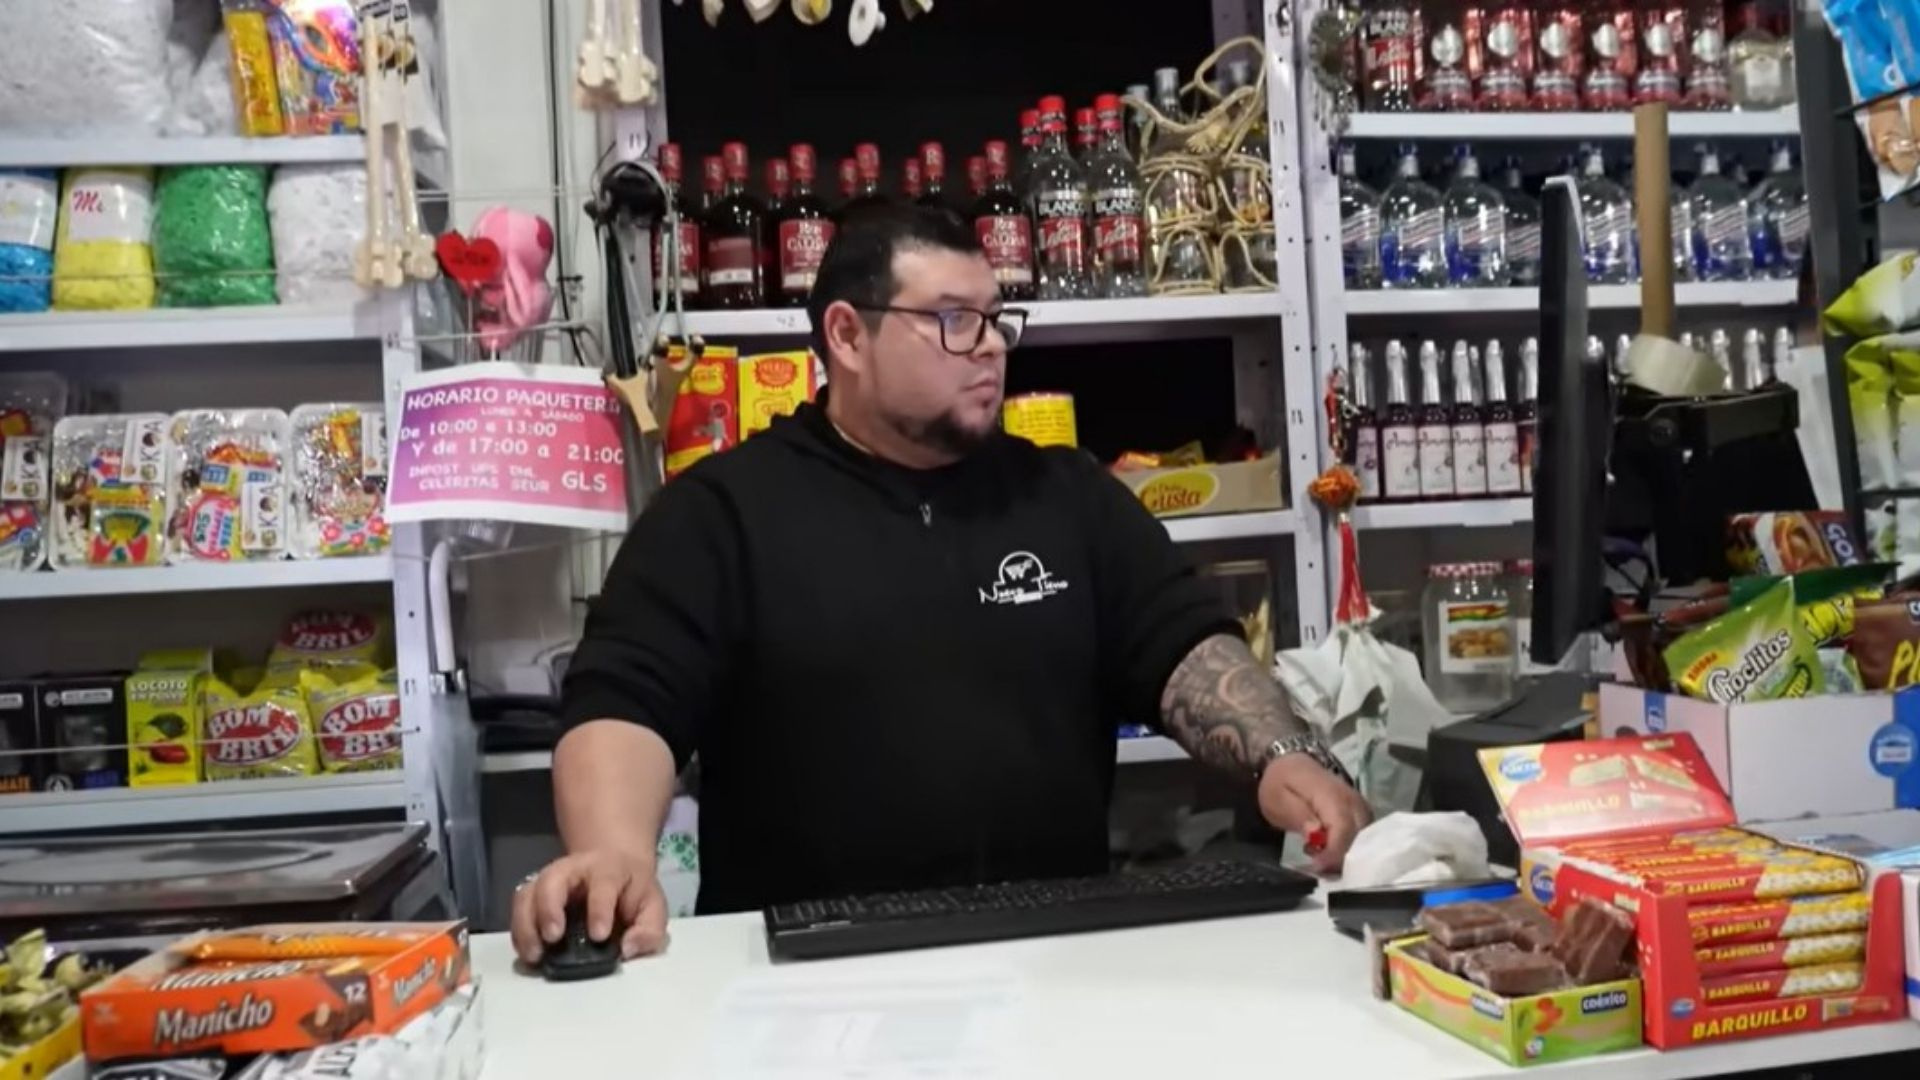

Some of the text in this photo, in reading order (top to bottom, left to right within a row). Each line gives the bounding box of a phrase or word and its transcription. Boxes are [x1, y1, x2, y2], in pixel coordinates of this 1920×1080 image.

[407, 387, 498, 411] HORARIO
[401, 426, 420, 441] De
[429, 418, 478, 436] 10:00
[507, 419, 558, 437] 13:00
[412, 442, 425, 458] Y
[431, 439, 458, 456] de
[469, 437, 528, 456] 17:00
[537, 444, 550, 458] a
[561, 470, 608, 493] GLS
[130, 679, 187, 693] LOCOTO
[208, 704, 270, 739] BOM
[324, 699, 390, 736] BOM
[217, 726, 297, 761] BRIL
[343, 982, 367, 1003] 12
[155, 993, 273, 1045] Manicho
[1691, 1004, 1807, 1040] BARQUILLO
